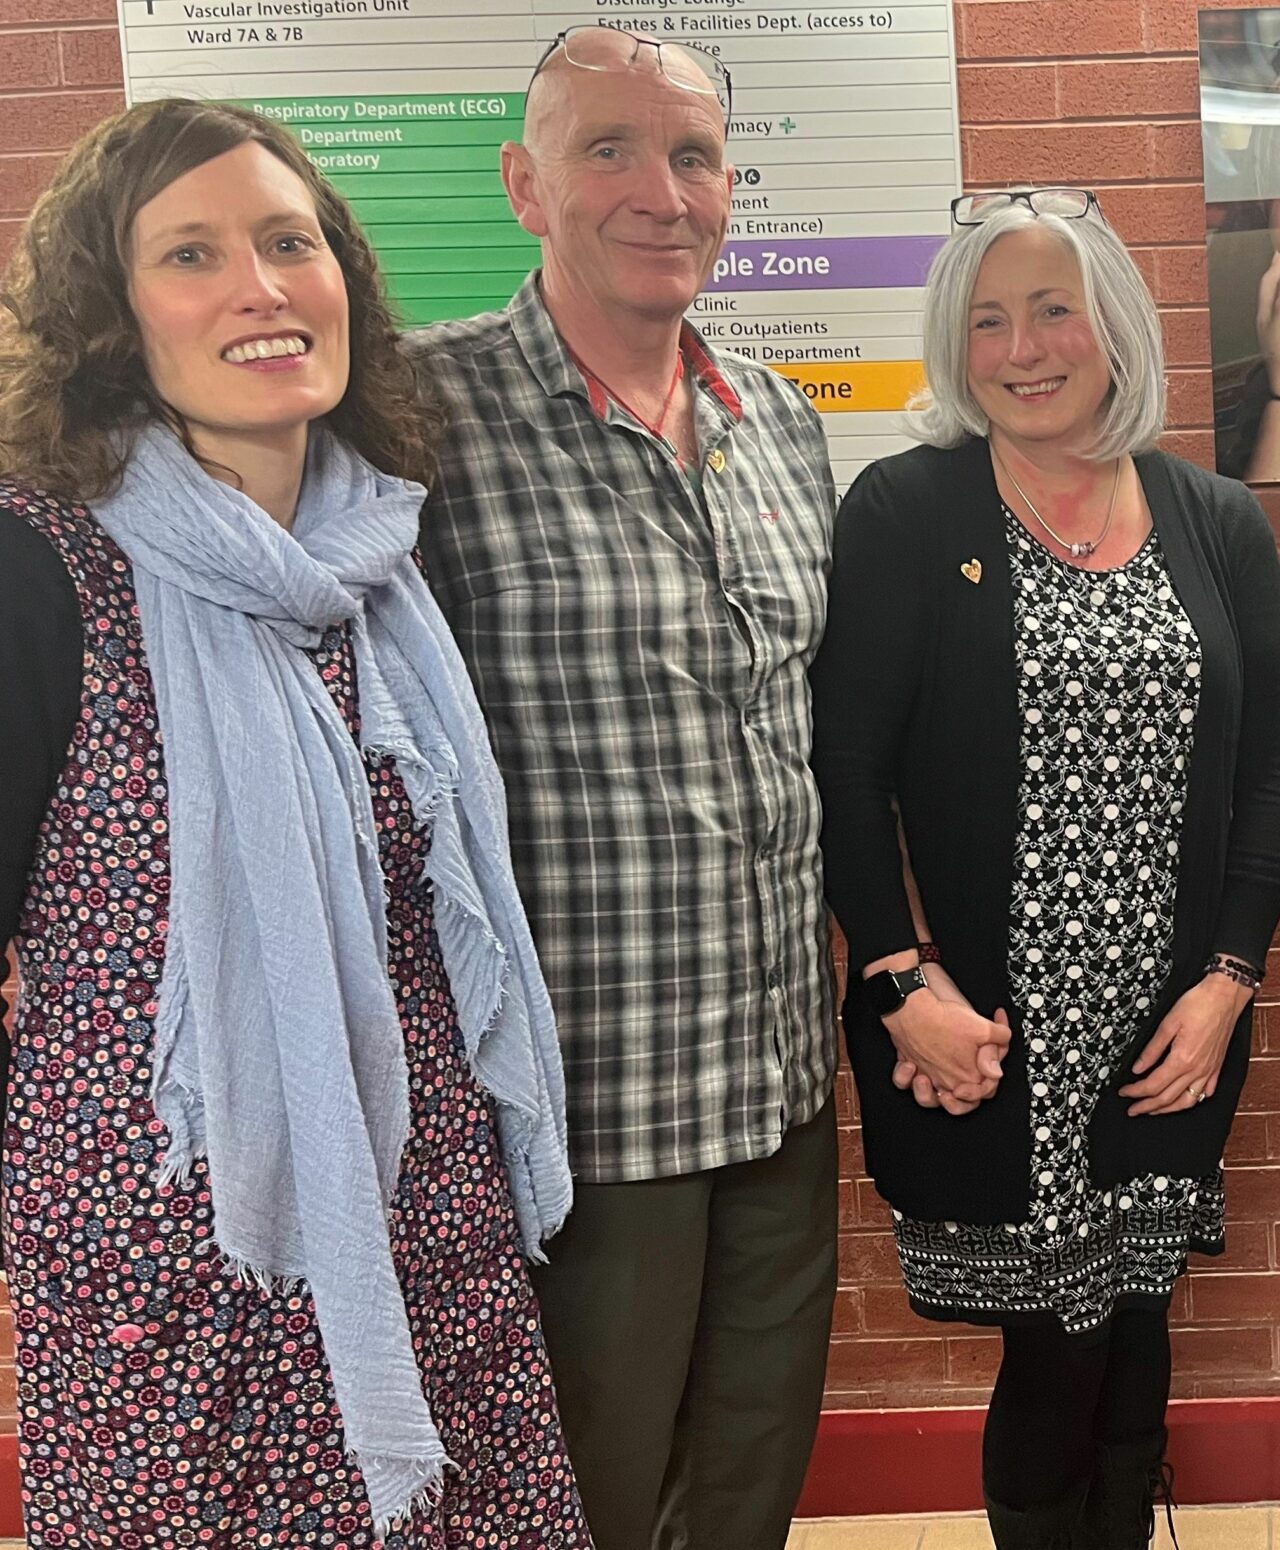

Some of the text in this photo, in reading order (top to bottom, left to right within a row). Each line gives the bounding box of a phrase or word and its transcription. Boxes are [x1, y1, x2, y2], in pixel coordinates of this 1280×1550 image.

[184, 0, 409, 19] Vascular Investigation Unit
[598, 11, 893, 33] Estates & Facilities Dept. (access to)
[187, 27, 304, 45] Ward 7A & 7B
[253, 98, 506, 122] Respiratory Department (ECG)
[301, 127, 403, 146] Department
[731, 121, 772, 136] macy
[308, 152, 380, 170] boratory
[747, 218, 823, 235] Entrance)
[762, 252, 830, 276] Zone
[693, 297, 737, 311] Clinic
[730, 320, 828, 339] Outpatients
[763, 345, 862, 363] Department
[795, 379, 852, 399] one
